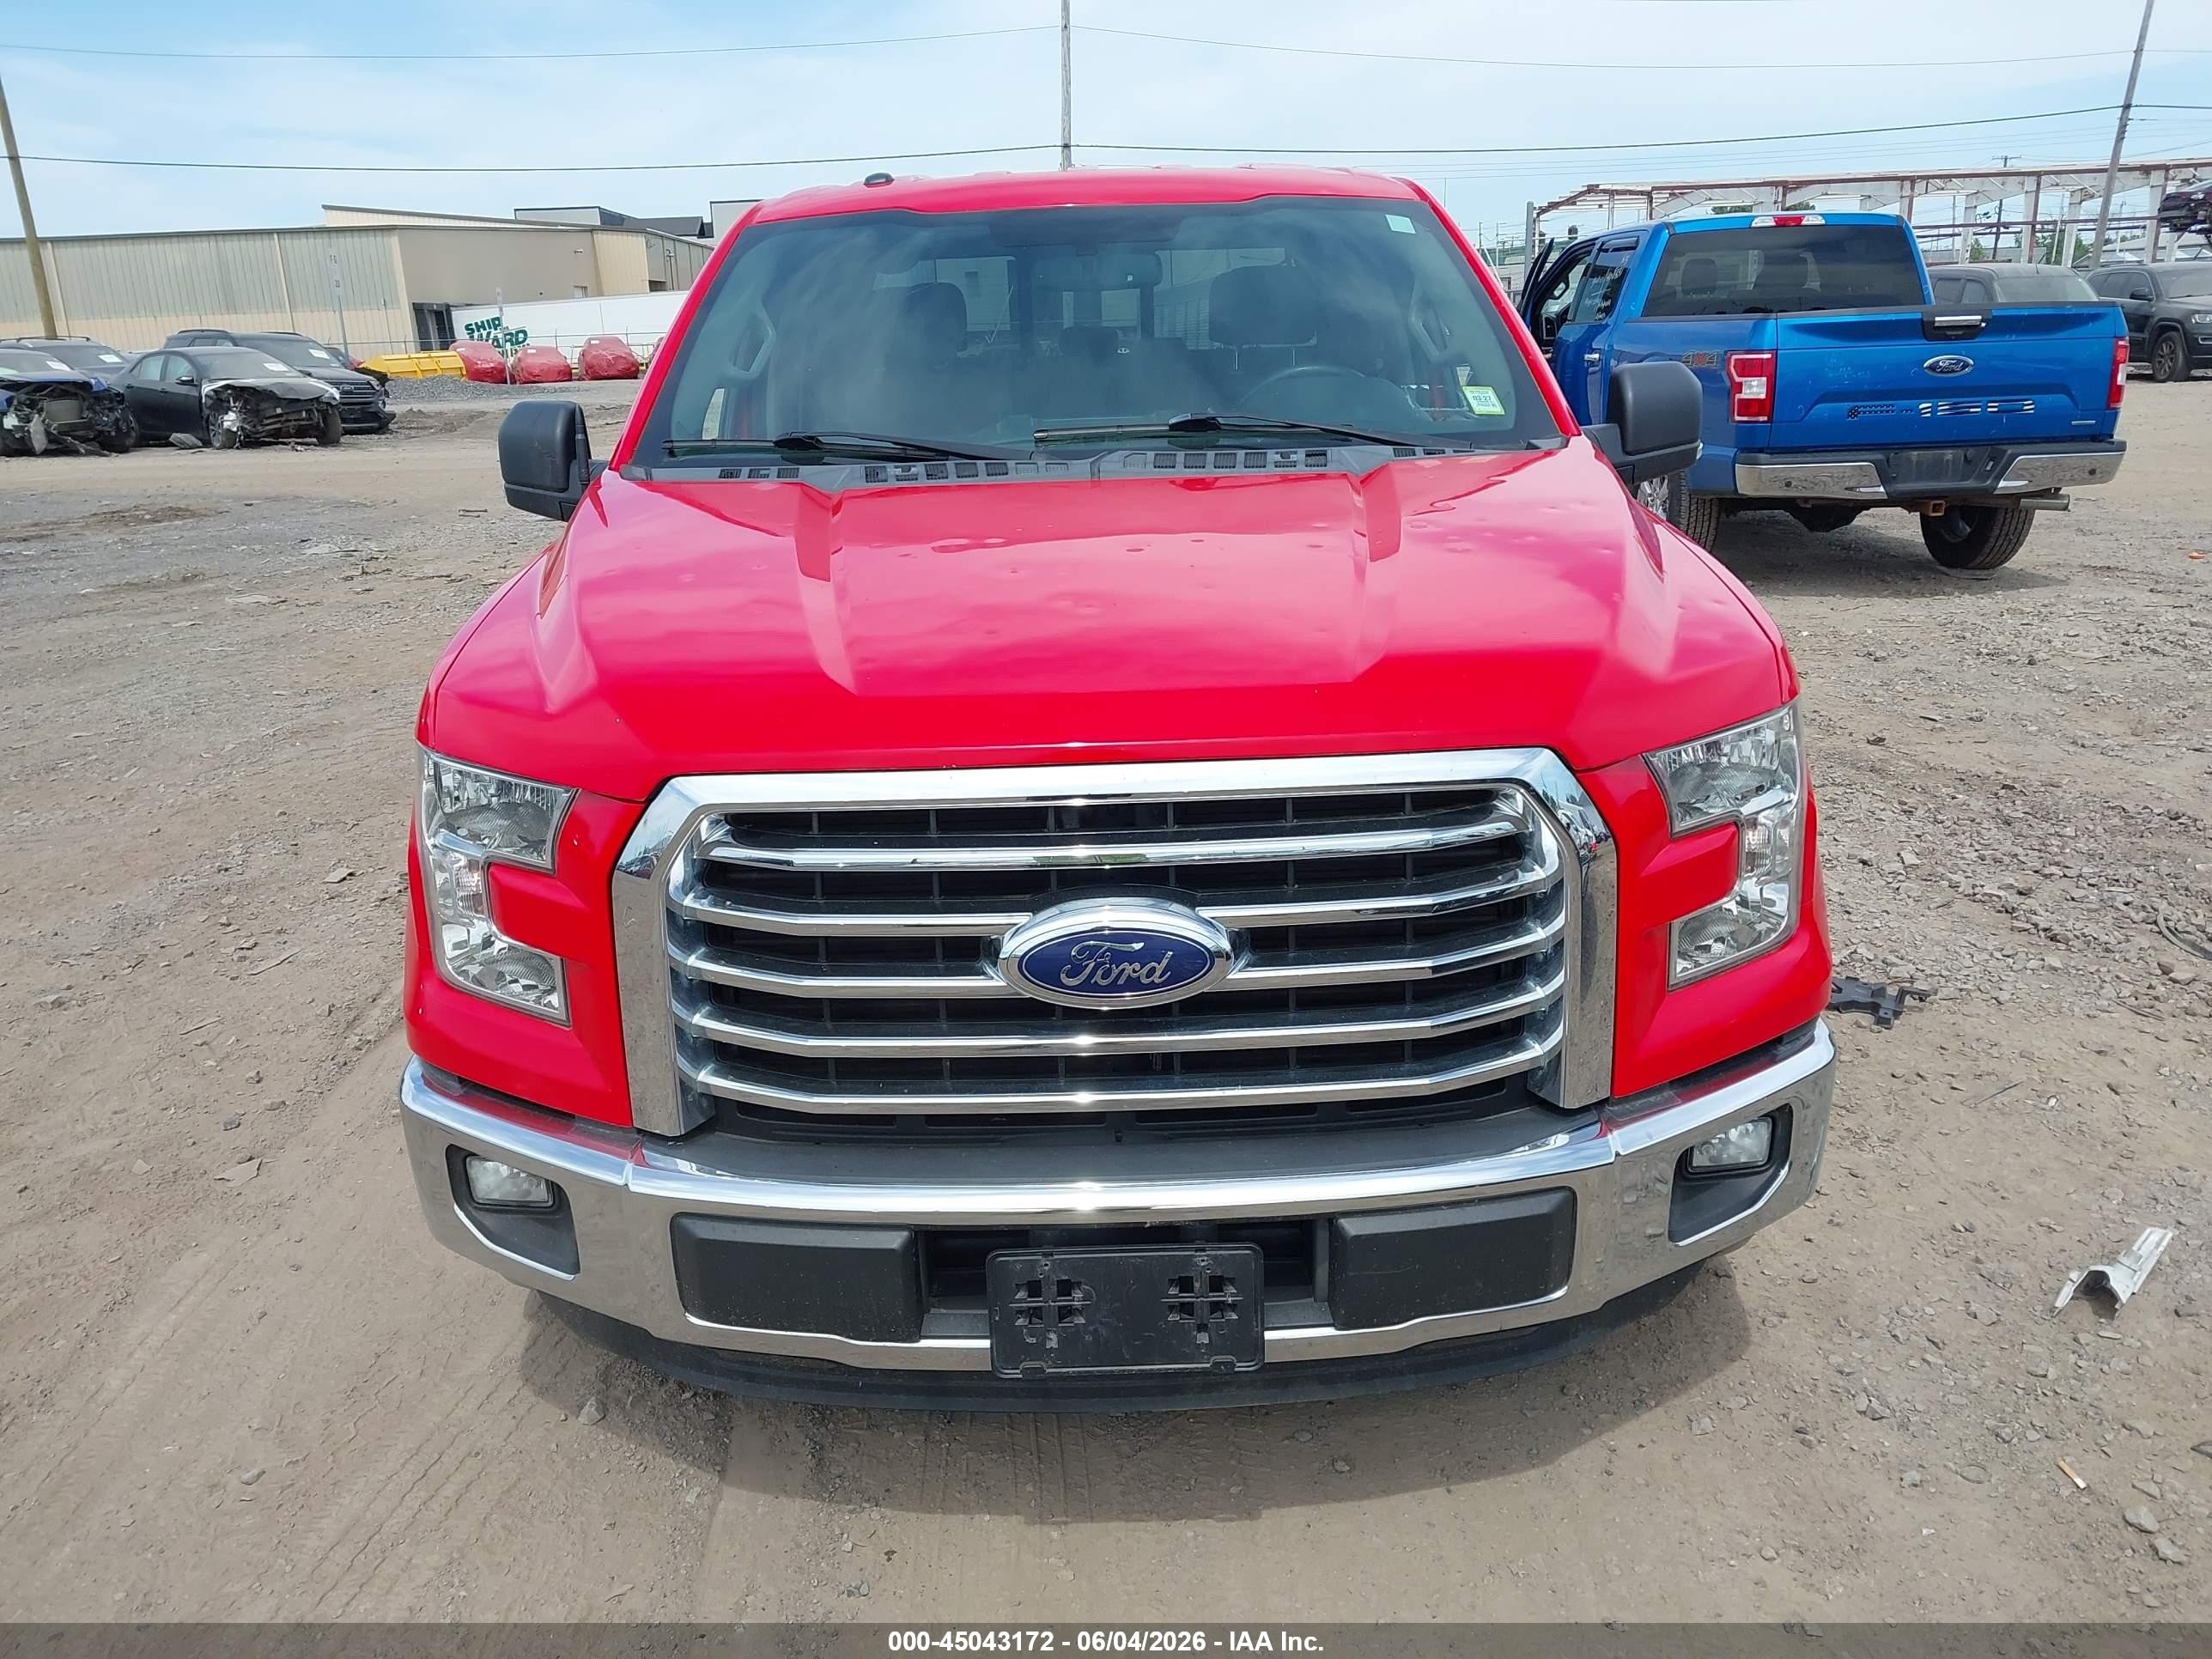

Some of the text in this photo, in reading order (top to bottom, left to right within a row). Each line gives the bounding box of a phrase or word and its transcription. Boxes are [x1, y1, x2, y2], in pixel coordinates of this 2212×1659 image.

[465, 317, 501, 335] SHIP
[1936, 359, 1964, 372] Ford
[1847, 398, 2035, 420] F-150
[1060, 940, 1174, 986] Ford
